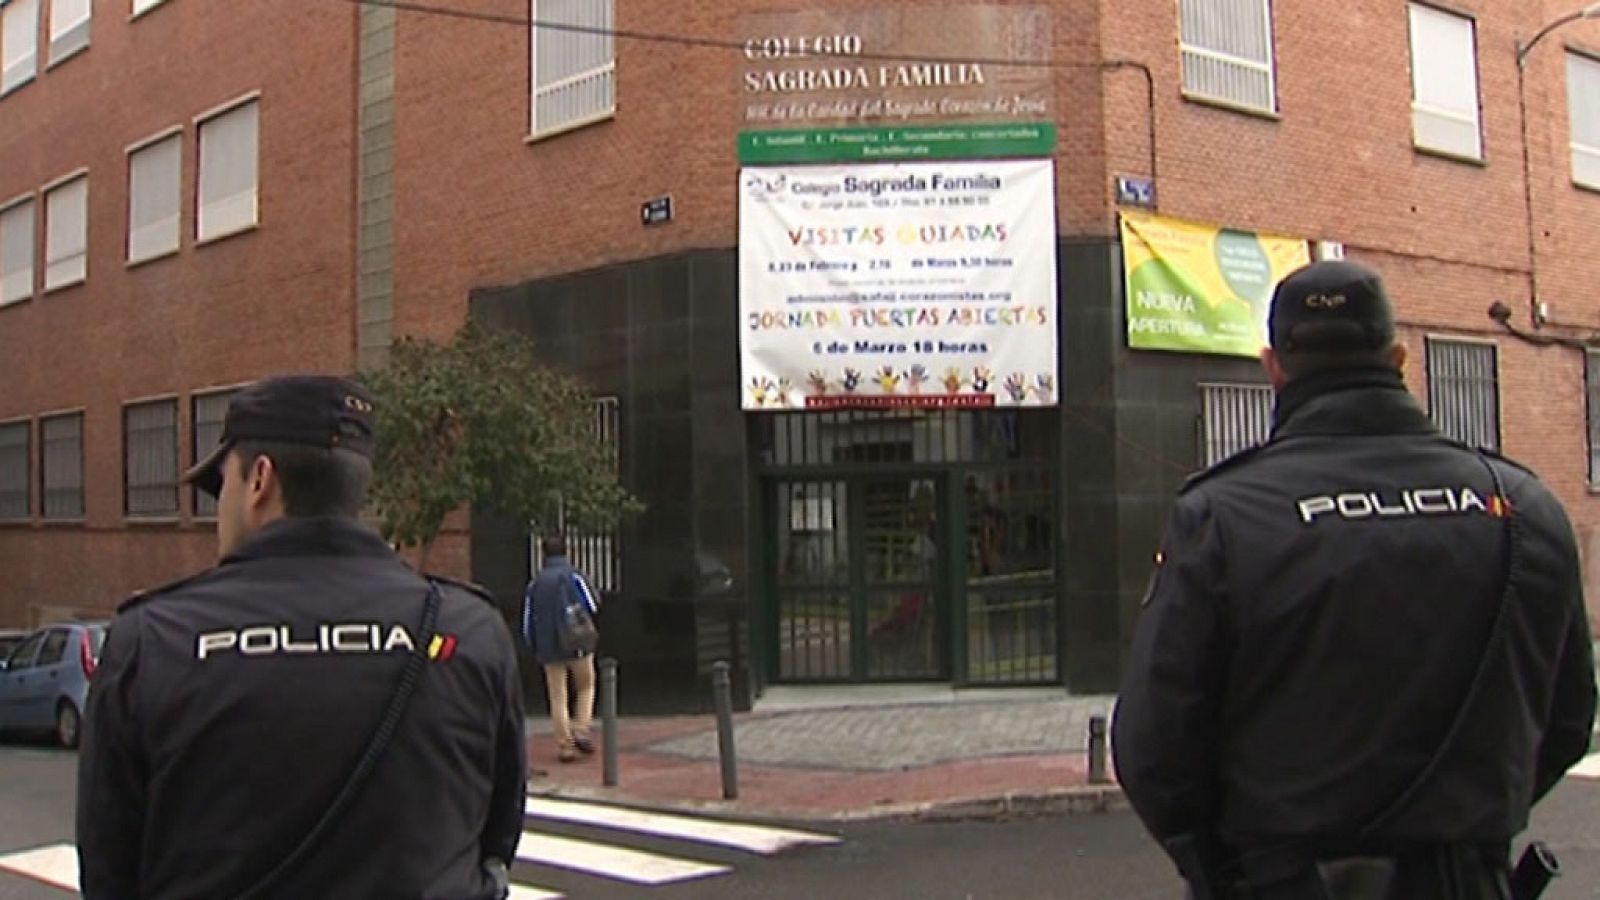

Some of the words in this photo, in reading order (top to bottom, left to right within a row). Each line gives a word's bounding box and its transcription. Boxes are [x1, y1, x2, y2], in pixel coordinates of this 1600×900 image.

[744, 33, 862, 59] COLEGIO
[744, 67, 869, 92] SAGRADA
[879, 64, 985, 87] FAMILIA
[844, 175, 927, 196] Sagrada
[788, 226, 885, 245] VISITAS
[1136, 290, 1196, 313] NUEVA
[749, 309, 842, 330] JORNADA
[850, 307, 939, 328] PUERTAS
[947, 306, 1046, 326] ABIERTAS
[827, 341, 849, 354] de
[854, 340, 907, 354] Marzo
[938, 340, 988, 353] horas
[1298, 488, 1486, 522] POLICIA
[198, 624, 415, 659] POLICIA
